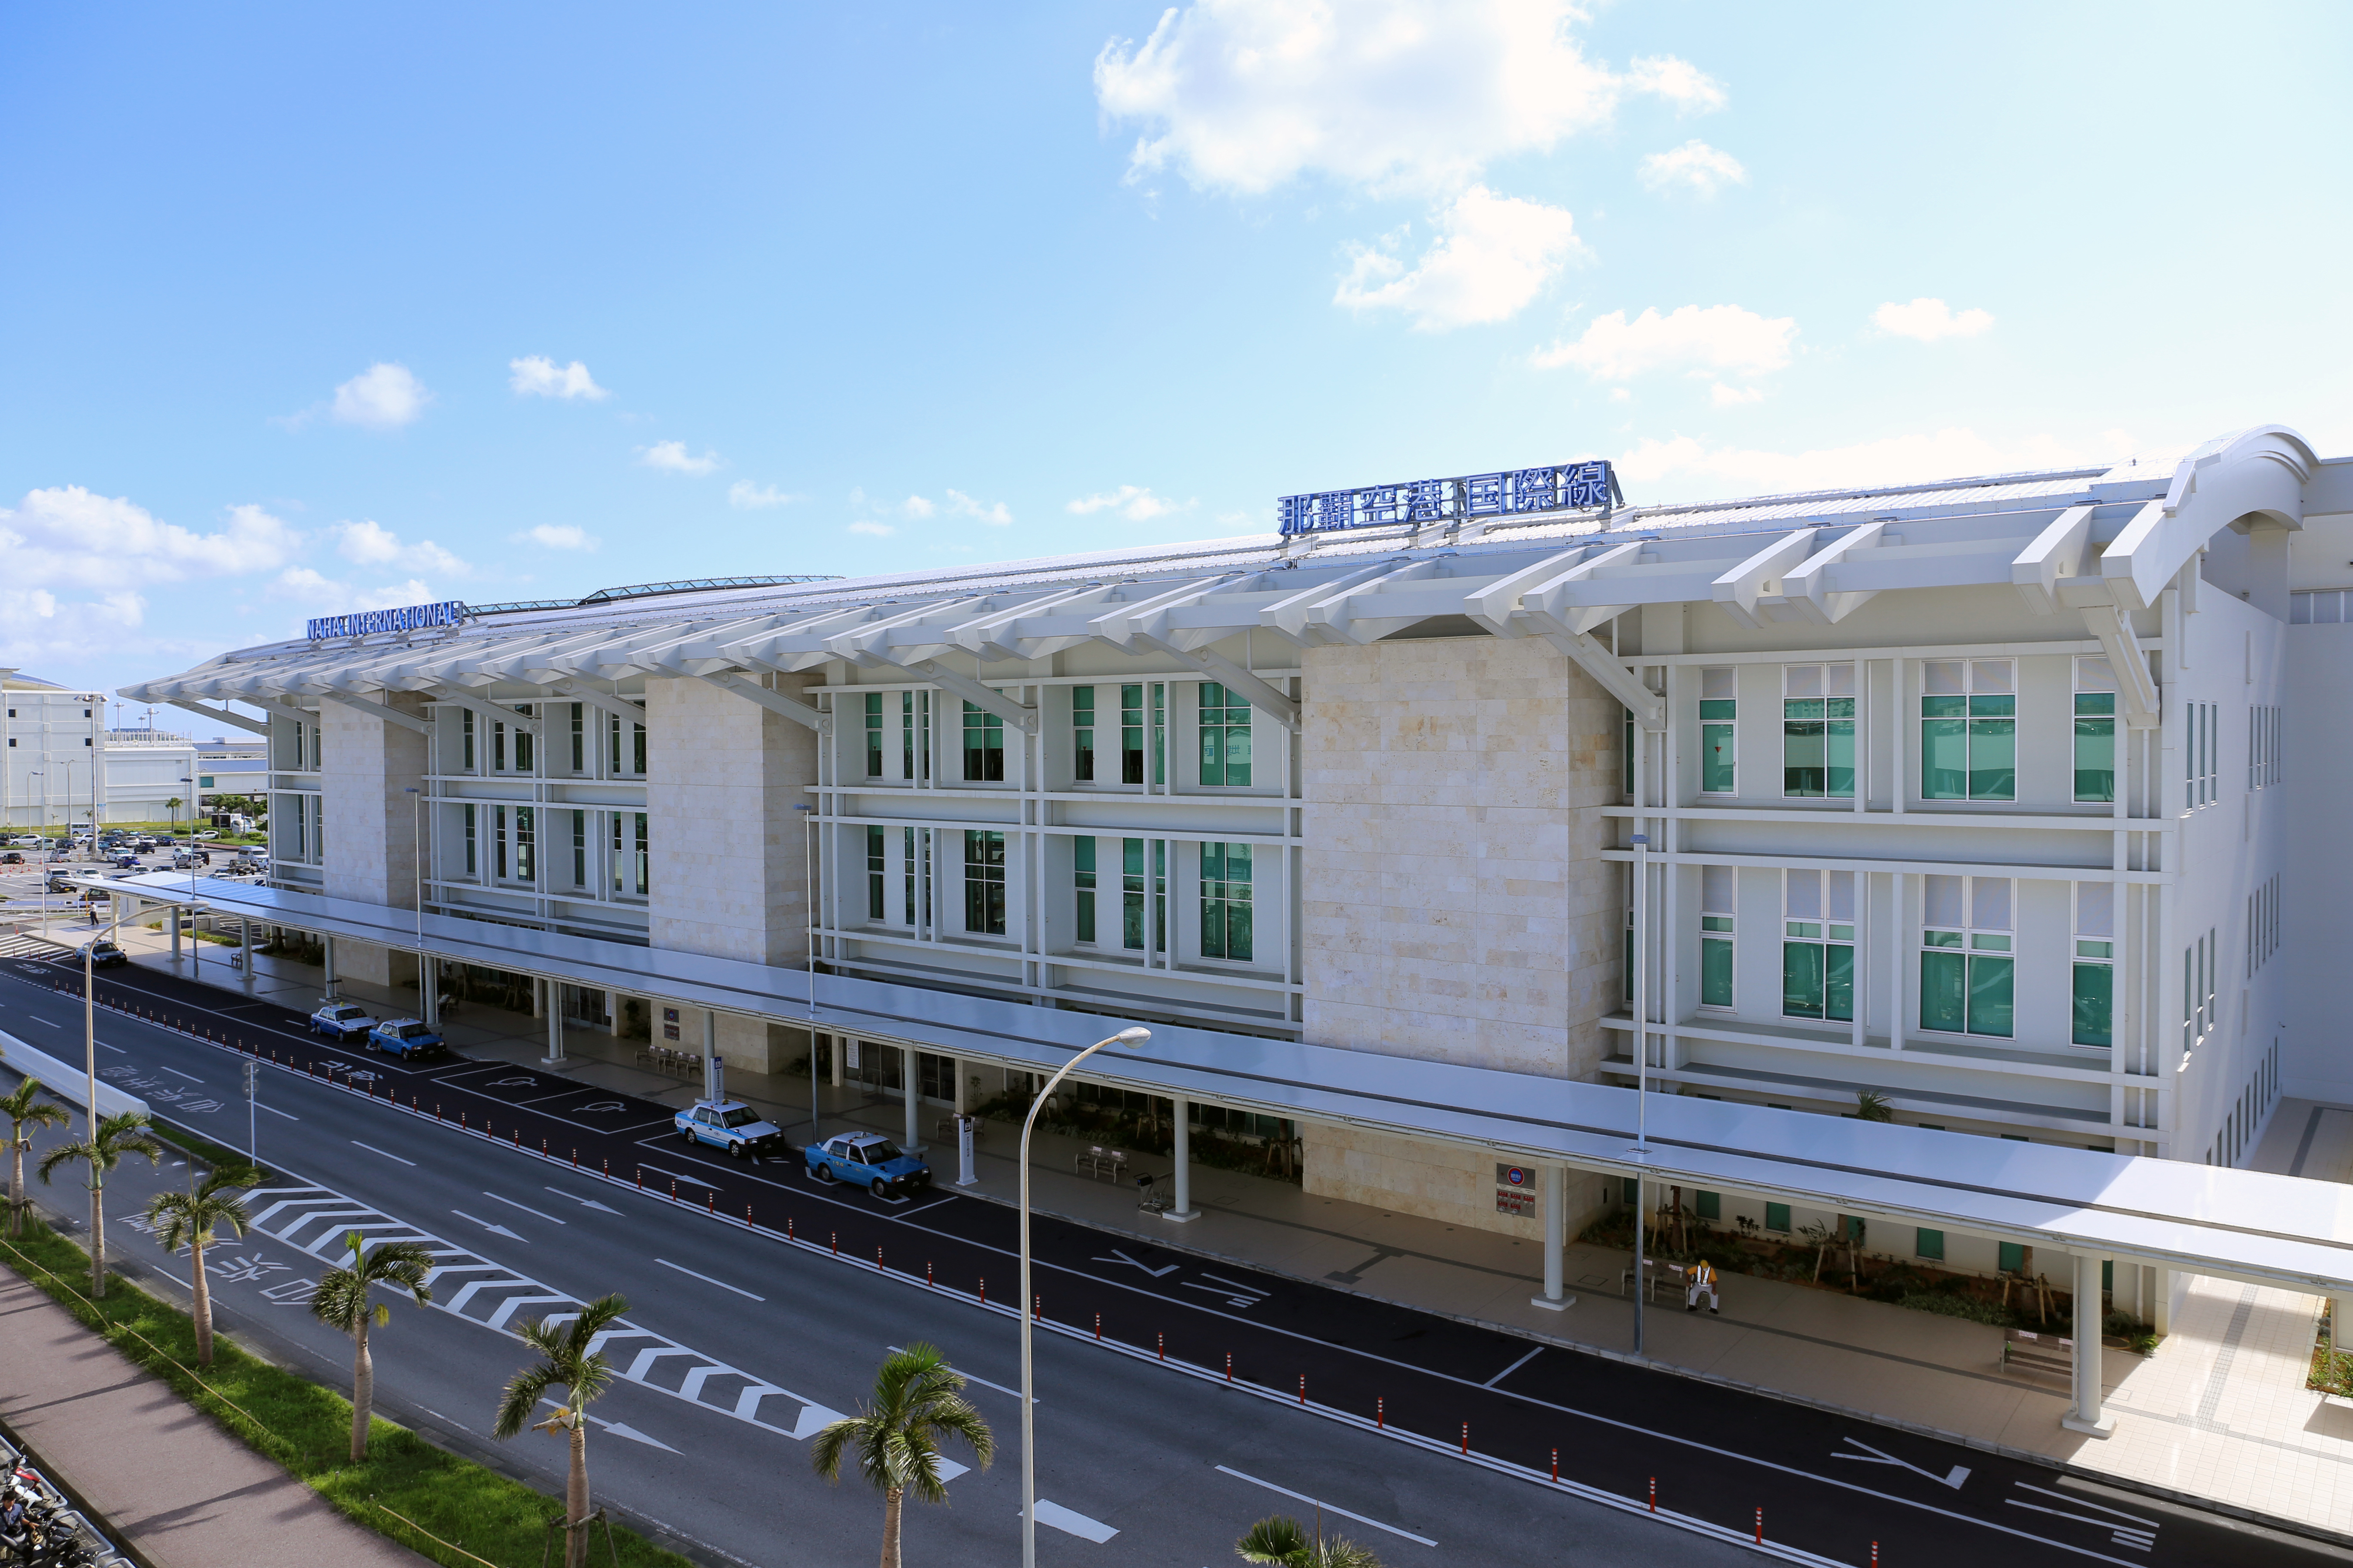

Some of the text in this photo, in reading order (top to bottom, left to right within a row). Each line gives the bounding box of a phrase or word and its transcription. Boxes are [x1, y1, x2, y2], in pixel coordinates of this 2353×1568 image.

[1277, 461, 1608, 536] 那覇空港 国際線
[306, 601, 458, 640] NAHA INTERNATIONAL
